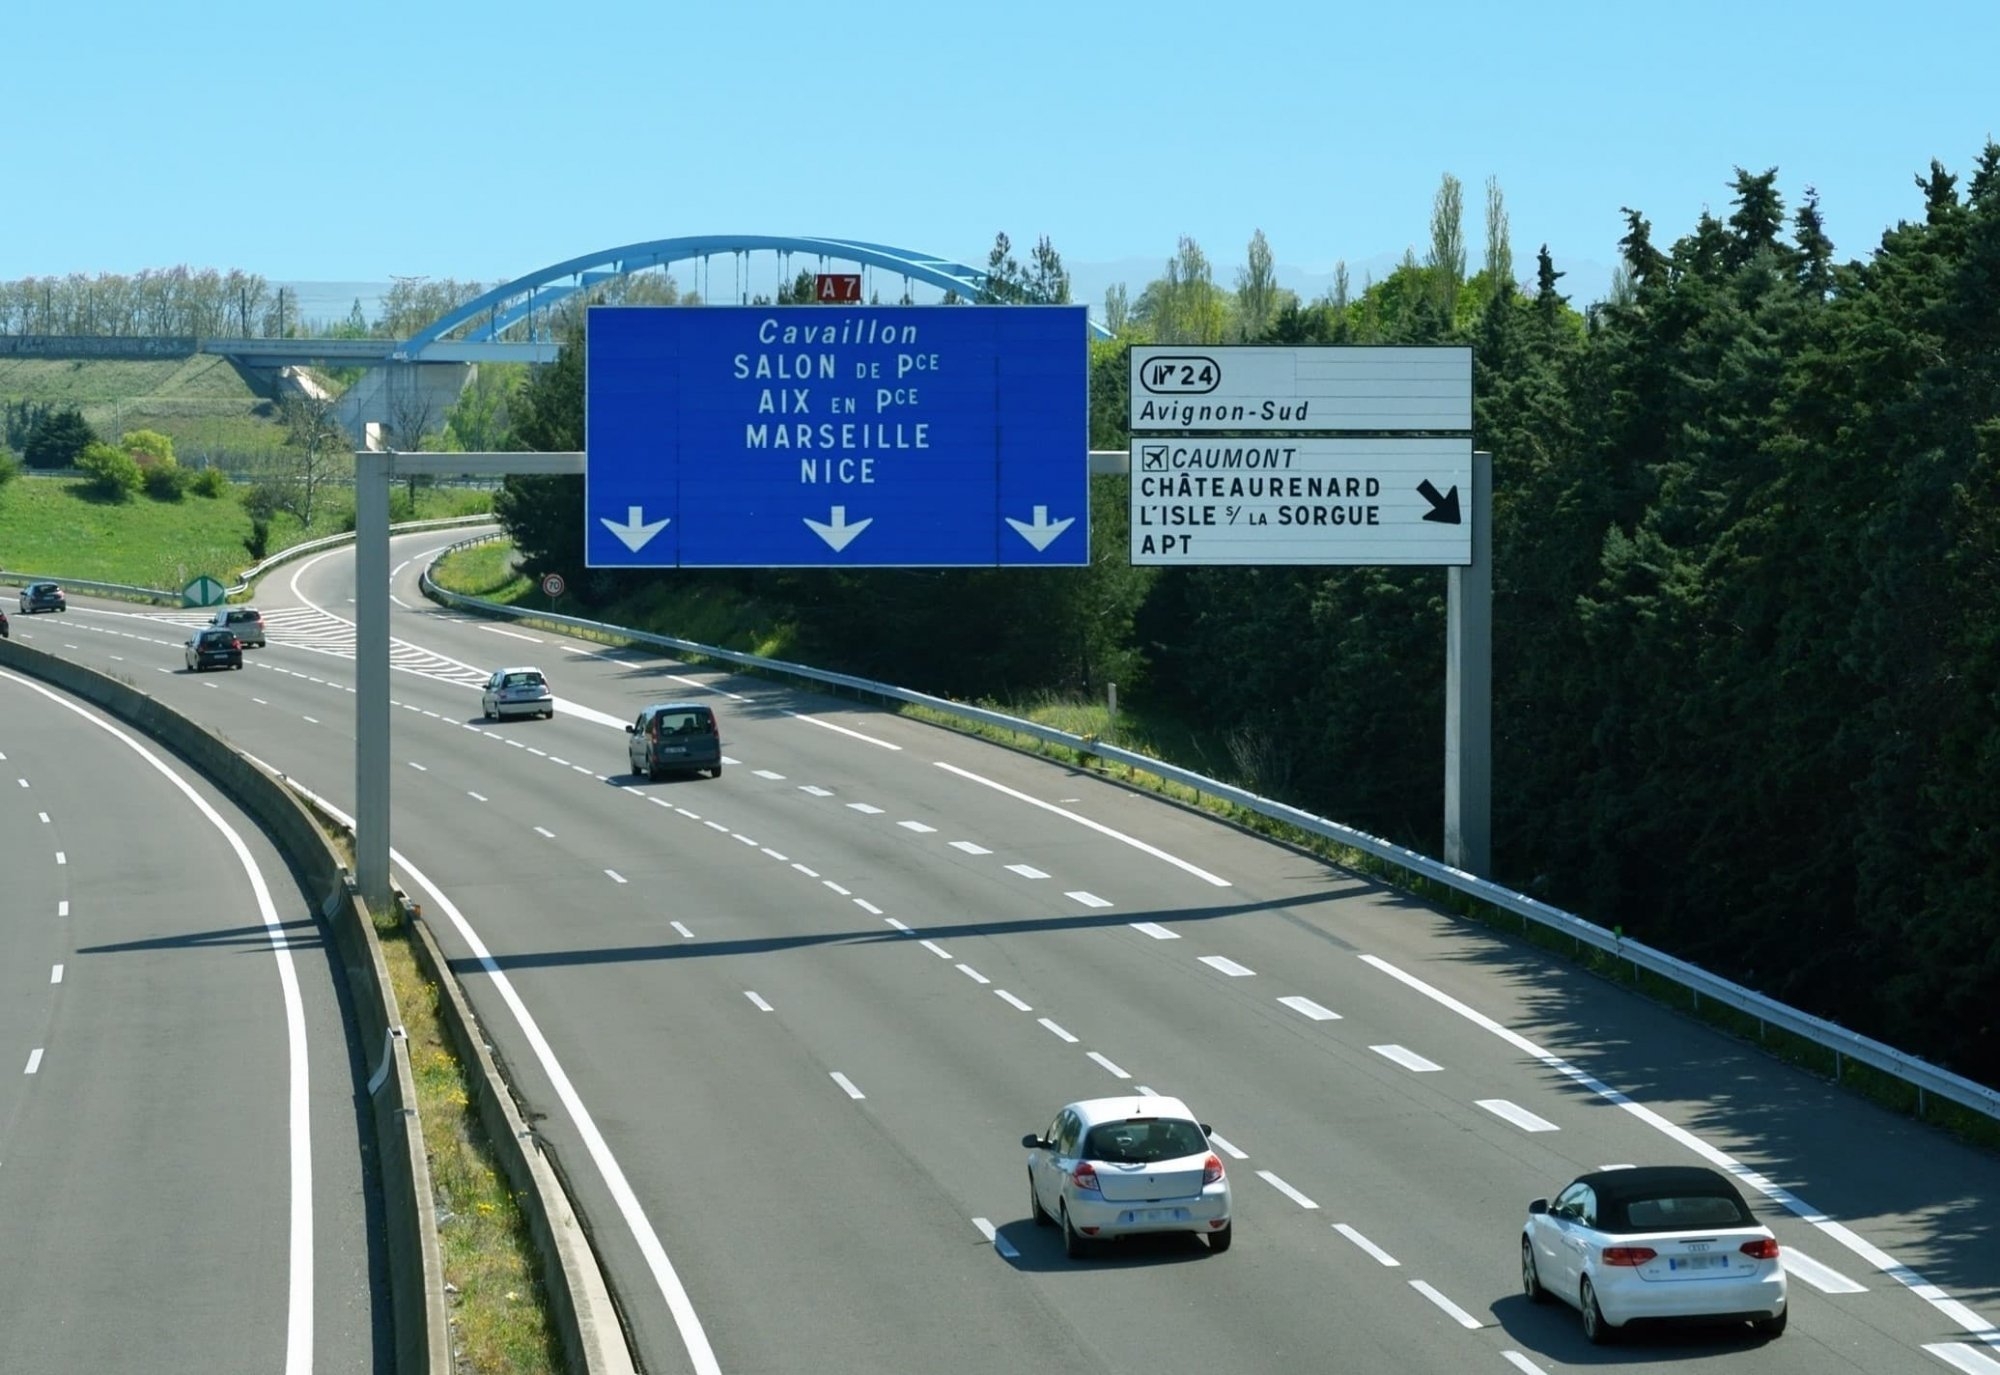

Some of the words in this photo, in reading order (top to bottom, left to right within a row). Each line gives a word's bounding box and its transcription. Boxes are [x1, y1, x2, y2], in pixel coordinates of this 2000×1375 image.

[822, 277, 836, 298] A
[843, 277, 857, 298] 7
[759, 318, 917, 344] Cavaillon
[734, 354, 835, 379] SALON
[856, 362, 880, 379] DE
[1180, 365, 1213, 386] 24
[758, 389, 810, 414] AIX
[831, 397, 856, 414] EN
[1140, 400, 1308, 426] Avignon-Sud
[746, 424, 929, 449] MARSEILLE
[801, 458, 875, 483] NICE
[1172, 448, 1296, 469] CAUMONT
[1141, 473, 1380, 498] CHÂTEAURENARD
[1141, 505, 1216, 526] L'ISLE
[1249, 512, 1268, 526] LA
[1278, 505, 1380, 526] SORGUE
[1141, 534, 1192, 555] APT
[549, 581, 560, 590] 70
